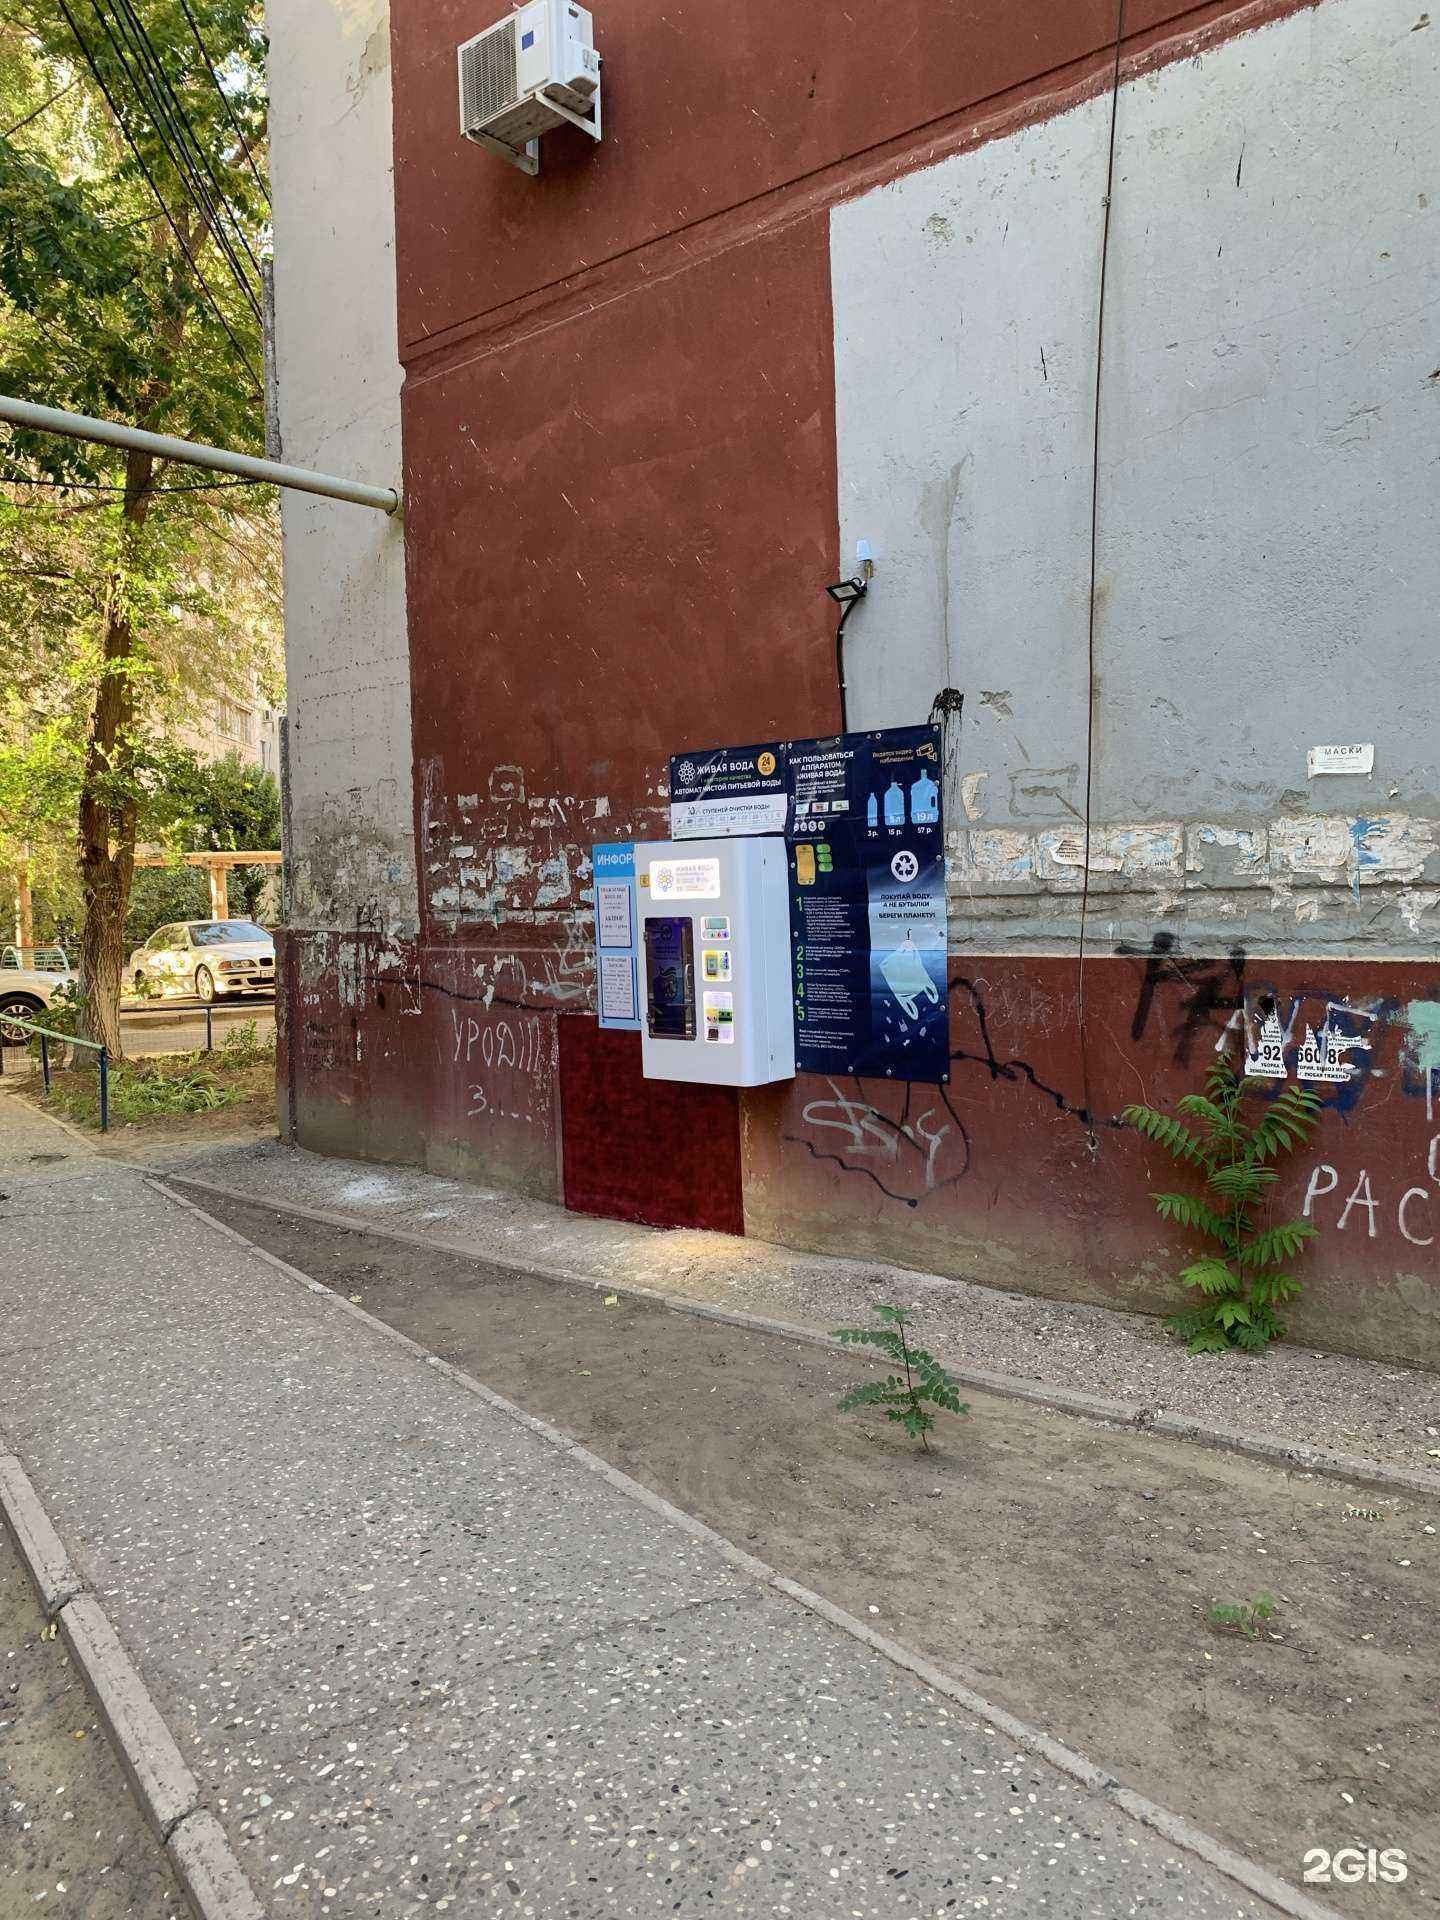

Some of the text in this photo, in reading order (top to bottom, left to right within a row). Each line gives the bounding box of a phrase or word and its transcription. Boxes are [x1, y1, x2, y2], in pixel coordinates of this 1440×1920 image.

[1324, 746, 1362, 755] МАСКИ
[761, 756, 771, 766] 24
[789, 751, 854, 765] КАК ПОЛЬЗОВАТЬСЯ
[697, 763, 727, 775] ЖИВАЯ
[730, 761, 755, 772] ВОДА
[801, 761, 841, 771] АППАРАТОМ
[674, 779, 782, 796] АВТОМАТ ЧИСТОЙ ПИТЬЕВОЙ ВОДЫ
[916, 812, 926, 821] 19
[597, 853, 635, 865] ИНФОР
[796, 896, 803, 911] 1
[797, 945, 804, 961] 2
[797, 963, 804, 979] 3
[797, 982, 805, 998] 4
[797, 1005, 805, 1021] 5
